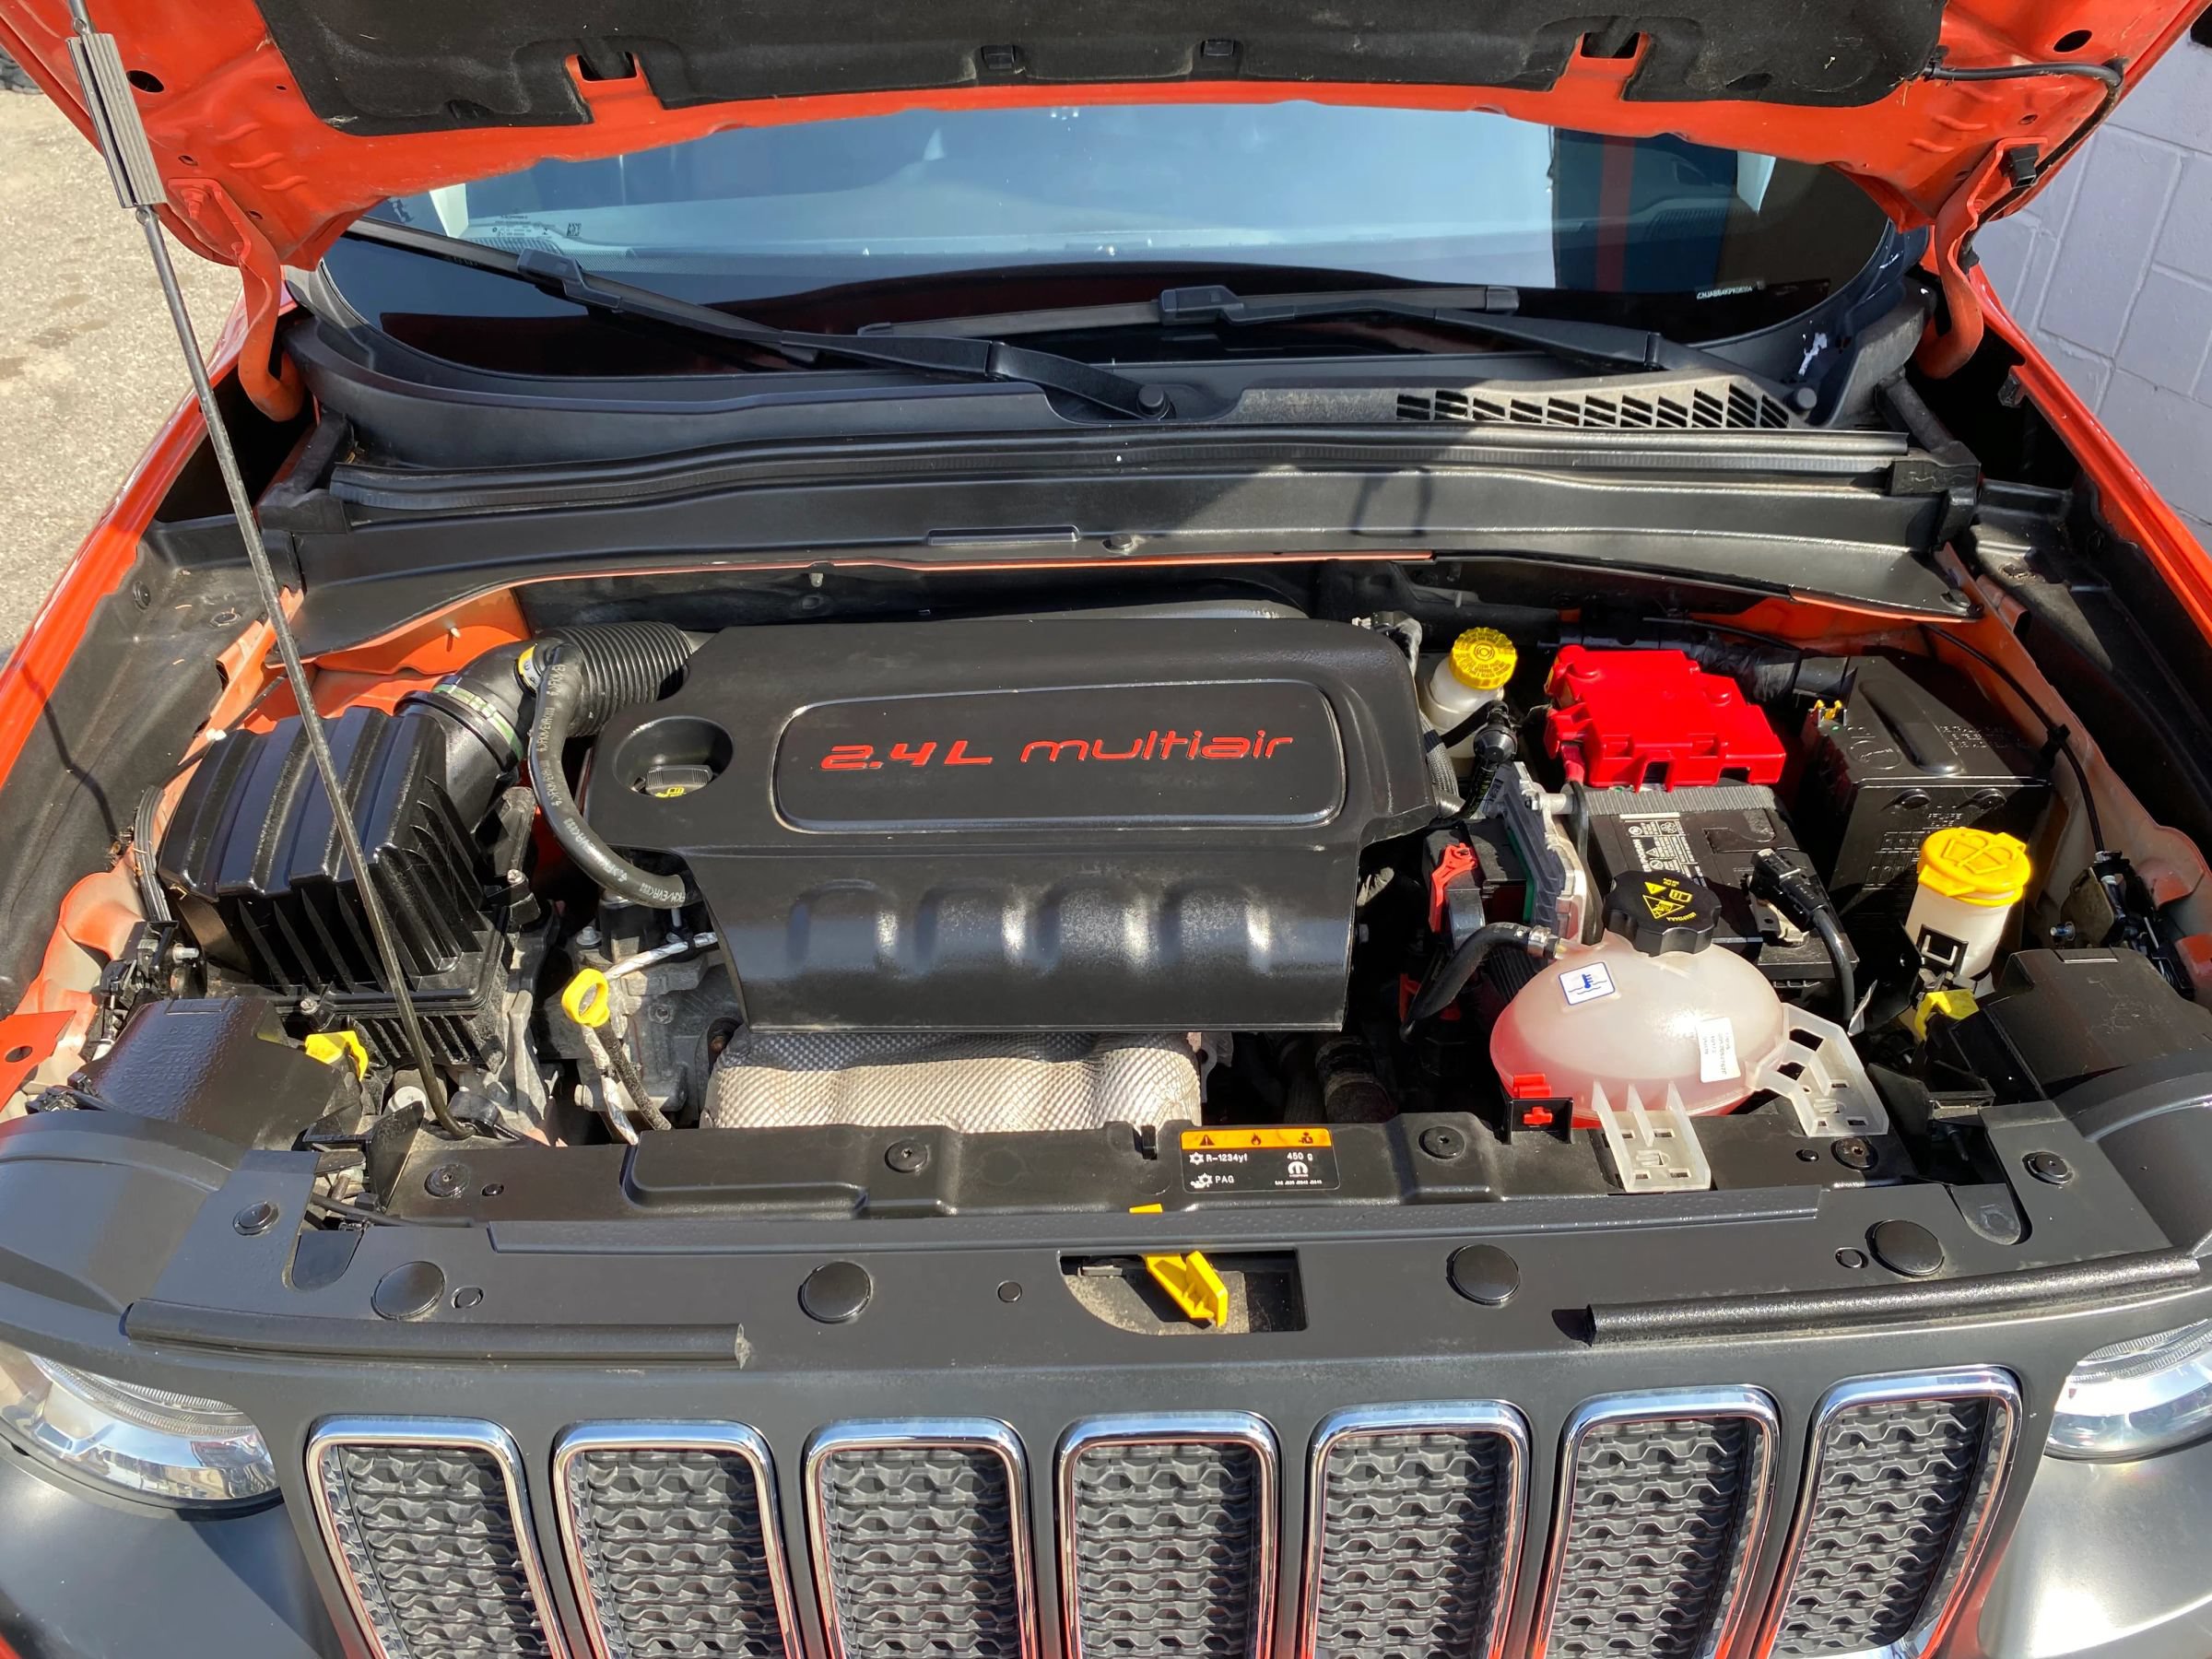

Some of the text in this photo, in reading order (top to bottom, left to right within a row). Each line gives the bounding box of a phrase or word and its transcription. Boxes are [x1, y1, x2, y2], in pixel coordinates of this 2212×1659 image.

[1019, 729, 1293, 763] multiair
[1206, 1152, 1248, 1164] R-1234yf
[1287, 1151, 1304, 1160] 450
[1215, 1174, 1235, 1183] PAG
